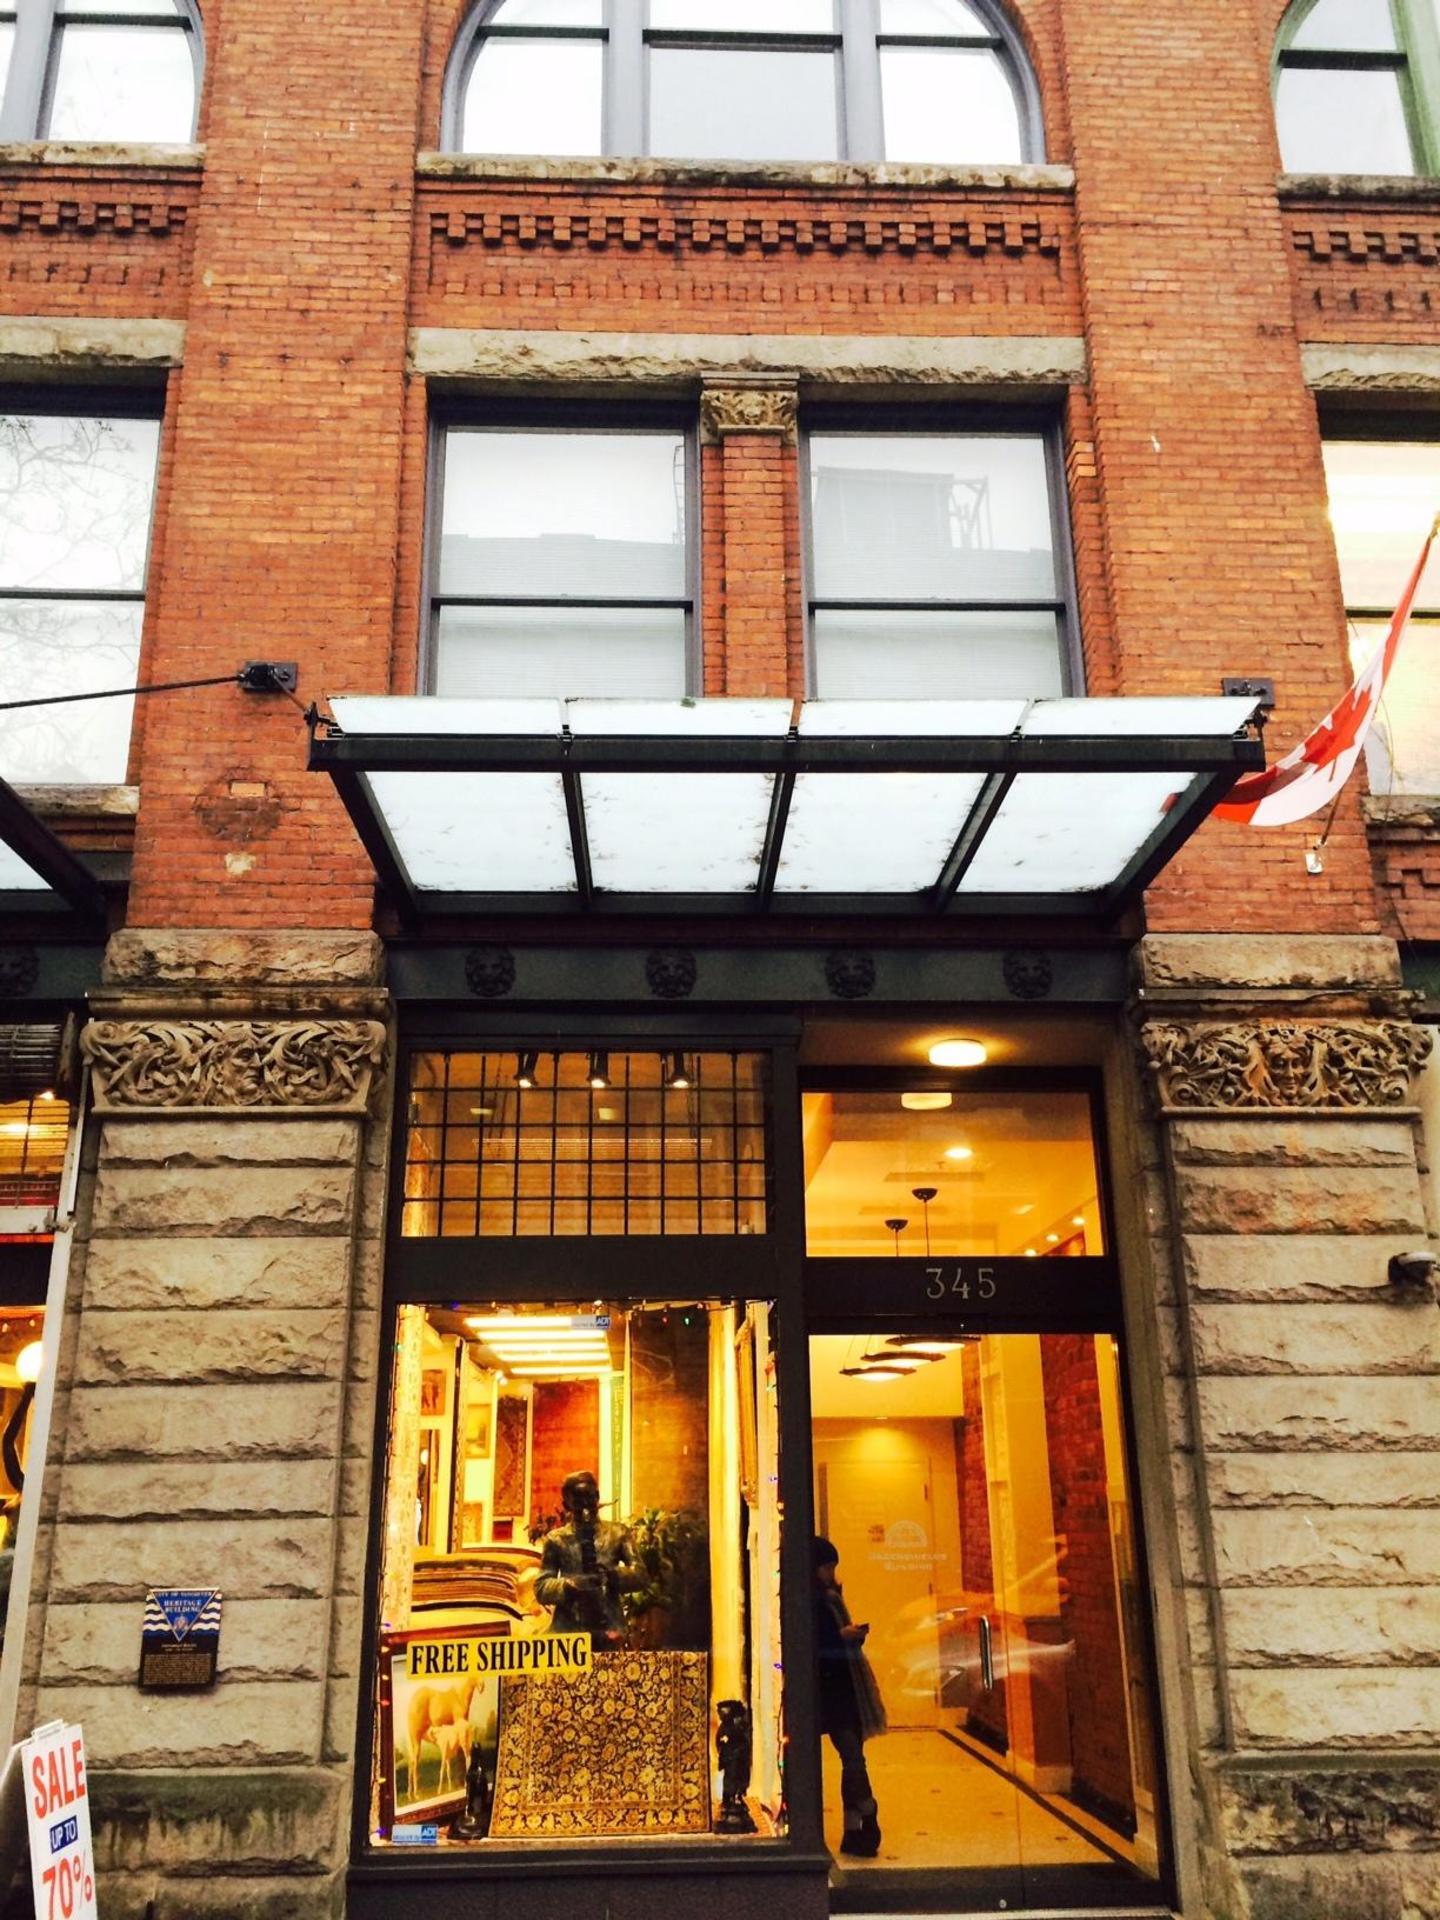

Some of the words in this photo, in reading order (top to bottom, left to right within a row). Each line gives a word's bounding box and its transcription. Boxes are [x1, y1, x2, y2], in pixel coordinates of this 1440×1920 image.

[926, 1267, 996, 1299] 345
[411, 1643, 469, 1675] FREE
[477, 1637, 587, 1671] SHIPPING
[32, 1739, 85, 1819] SALE
[51, 1828, 63, 1849] UP
[63, 1820, 77, 1842] TO
[42, 1849, 93, 1920] 70%
